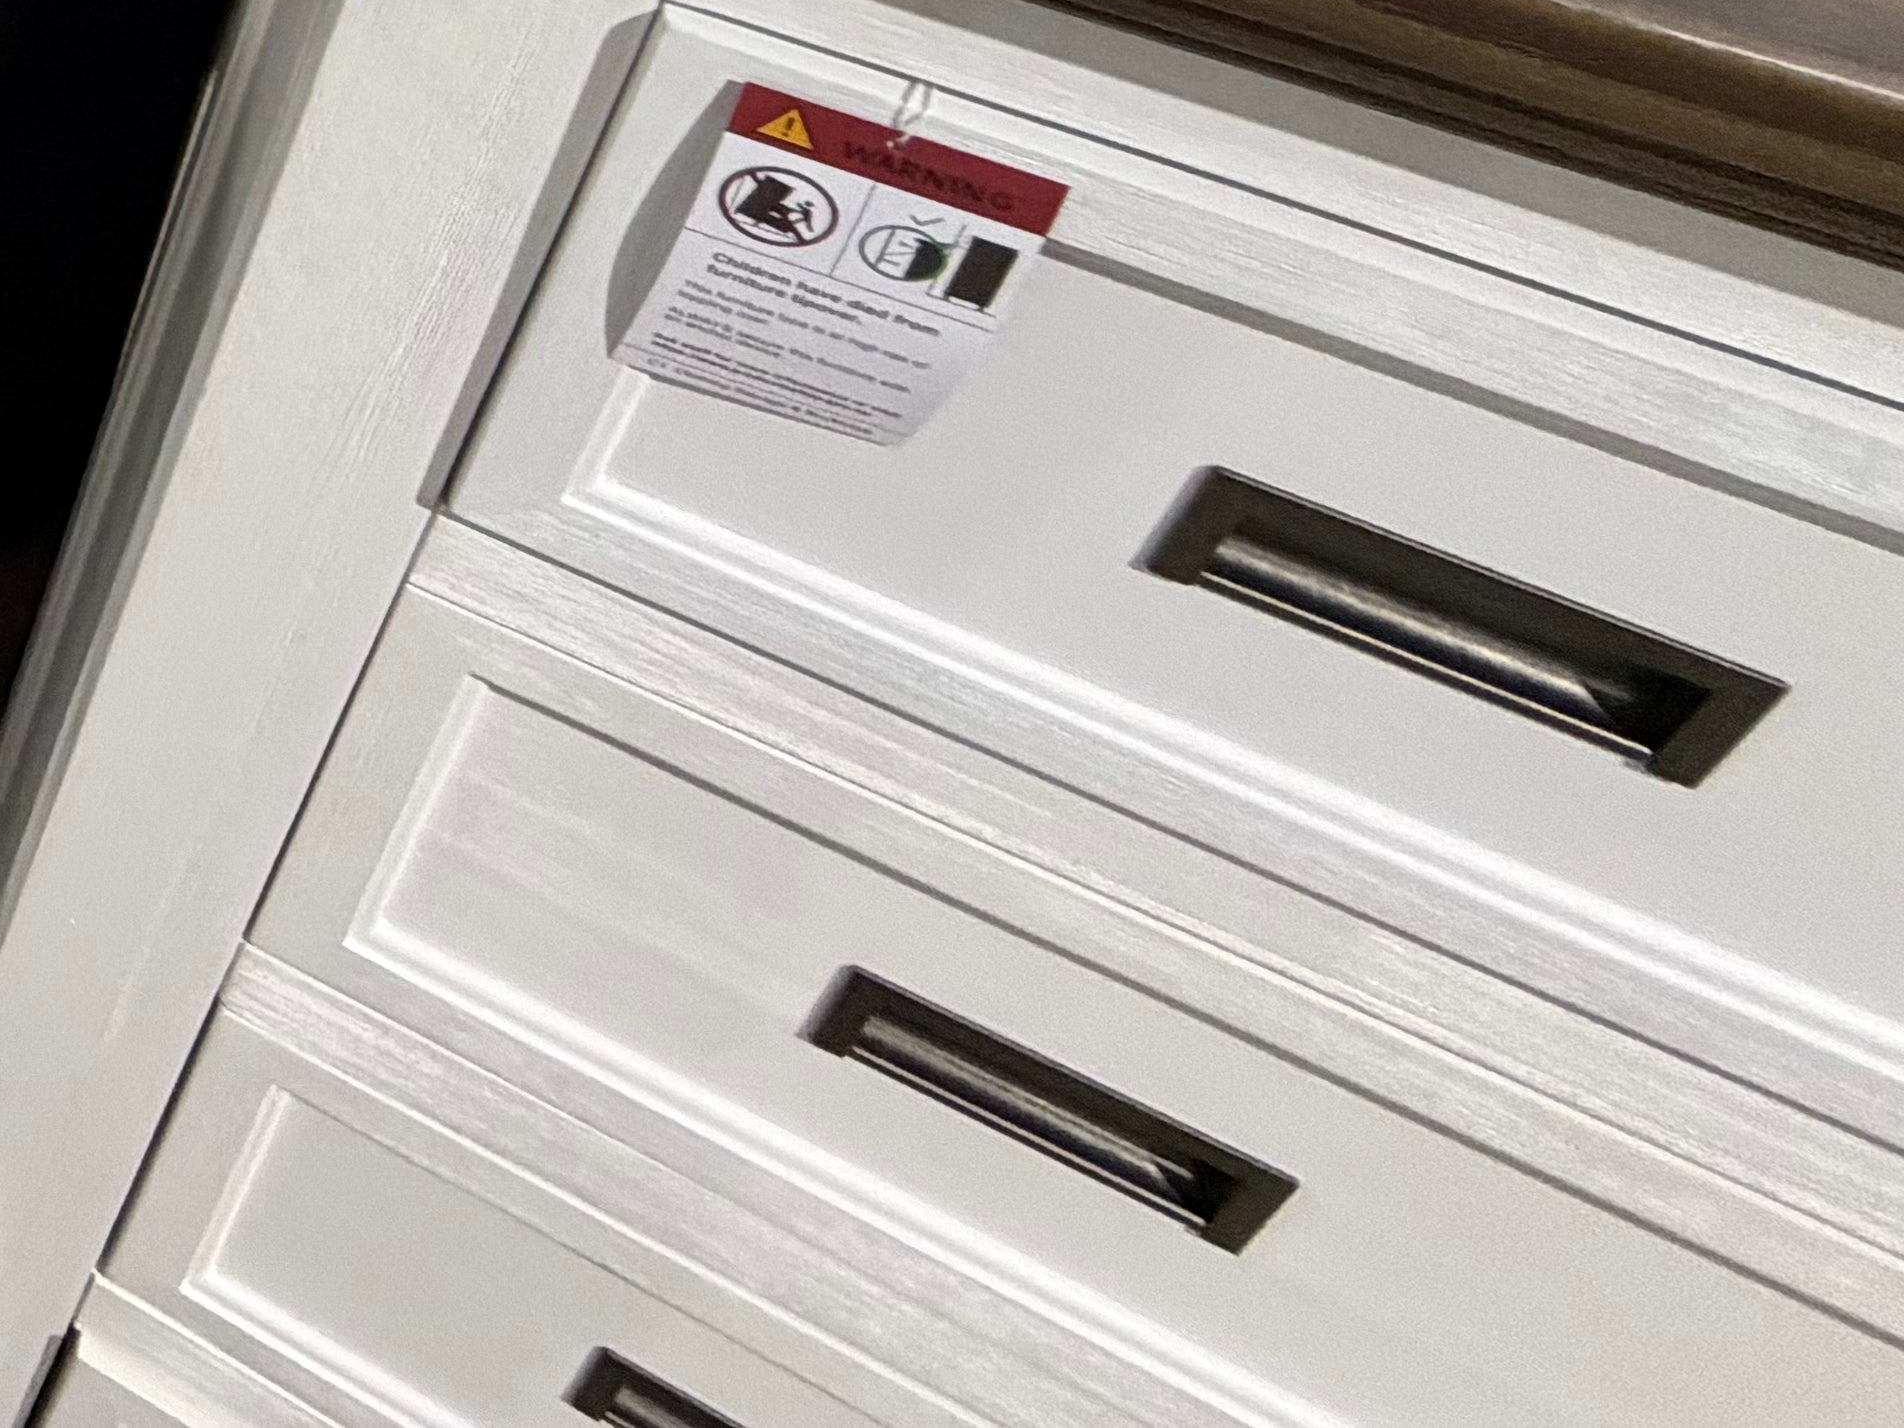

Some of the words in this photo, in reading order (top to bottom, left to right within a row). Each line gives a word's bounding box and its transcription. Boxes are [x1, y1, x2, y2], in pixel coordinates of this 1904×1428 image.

[845, 140, 1012, 210] WARNING
[707, 263, 787, 299] furniture
[712, 251, 792, 286] Children
[796, 281, 842, 303] have
[847, 300, 890, 319] died
[893, 314, 941, 336] from
